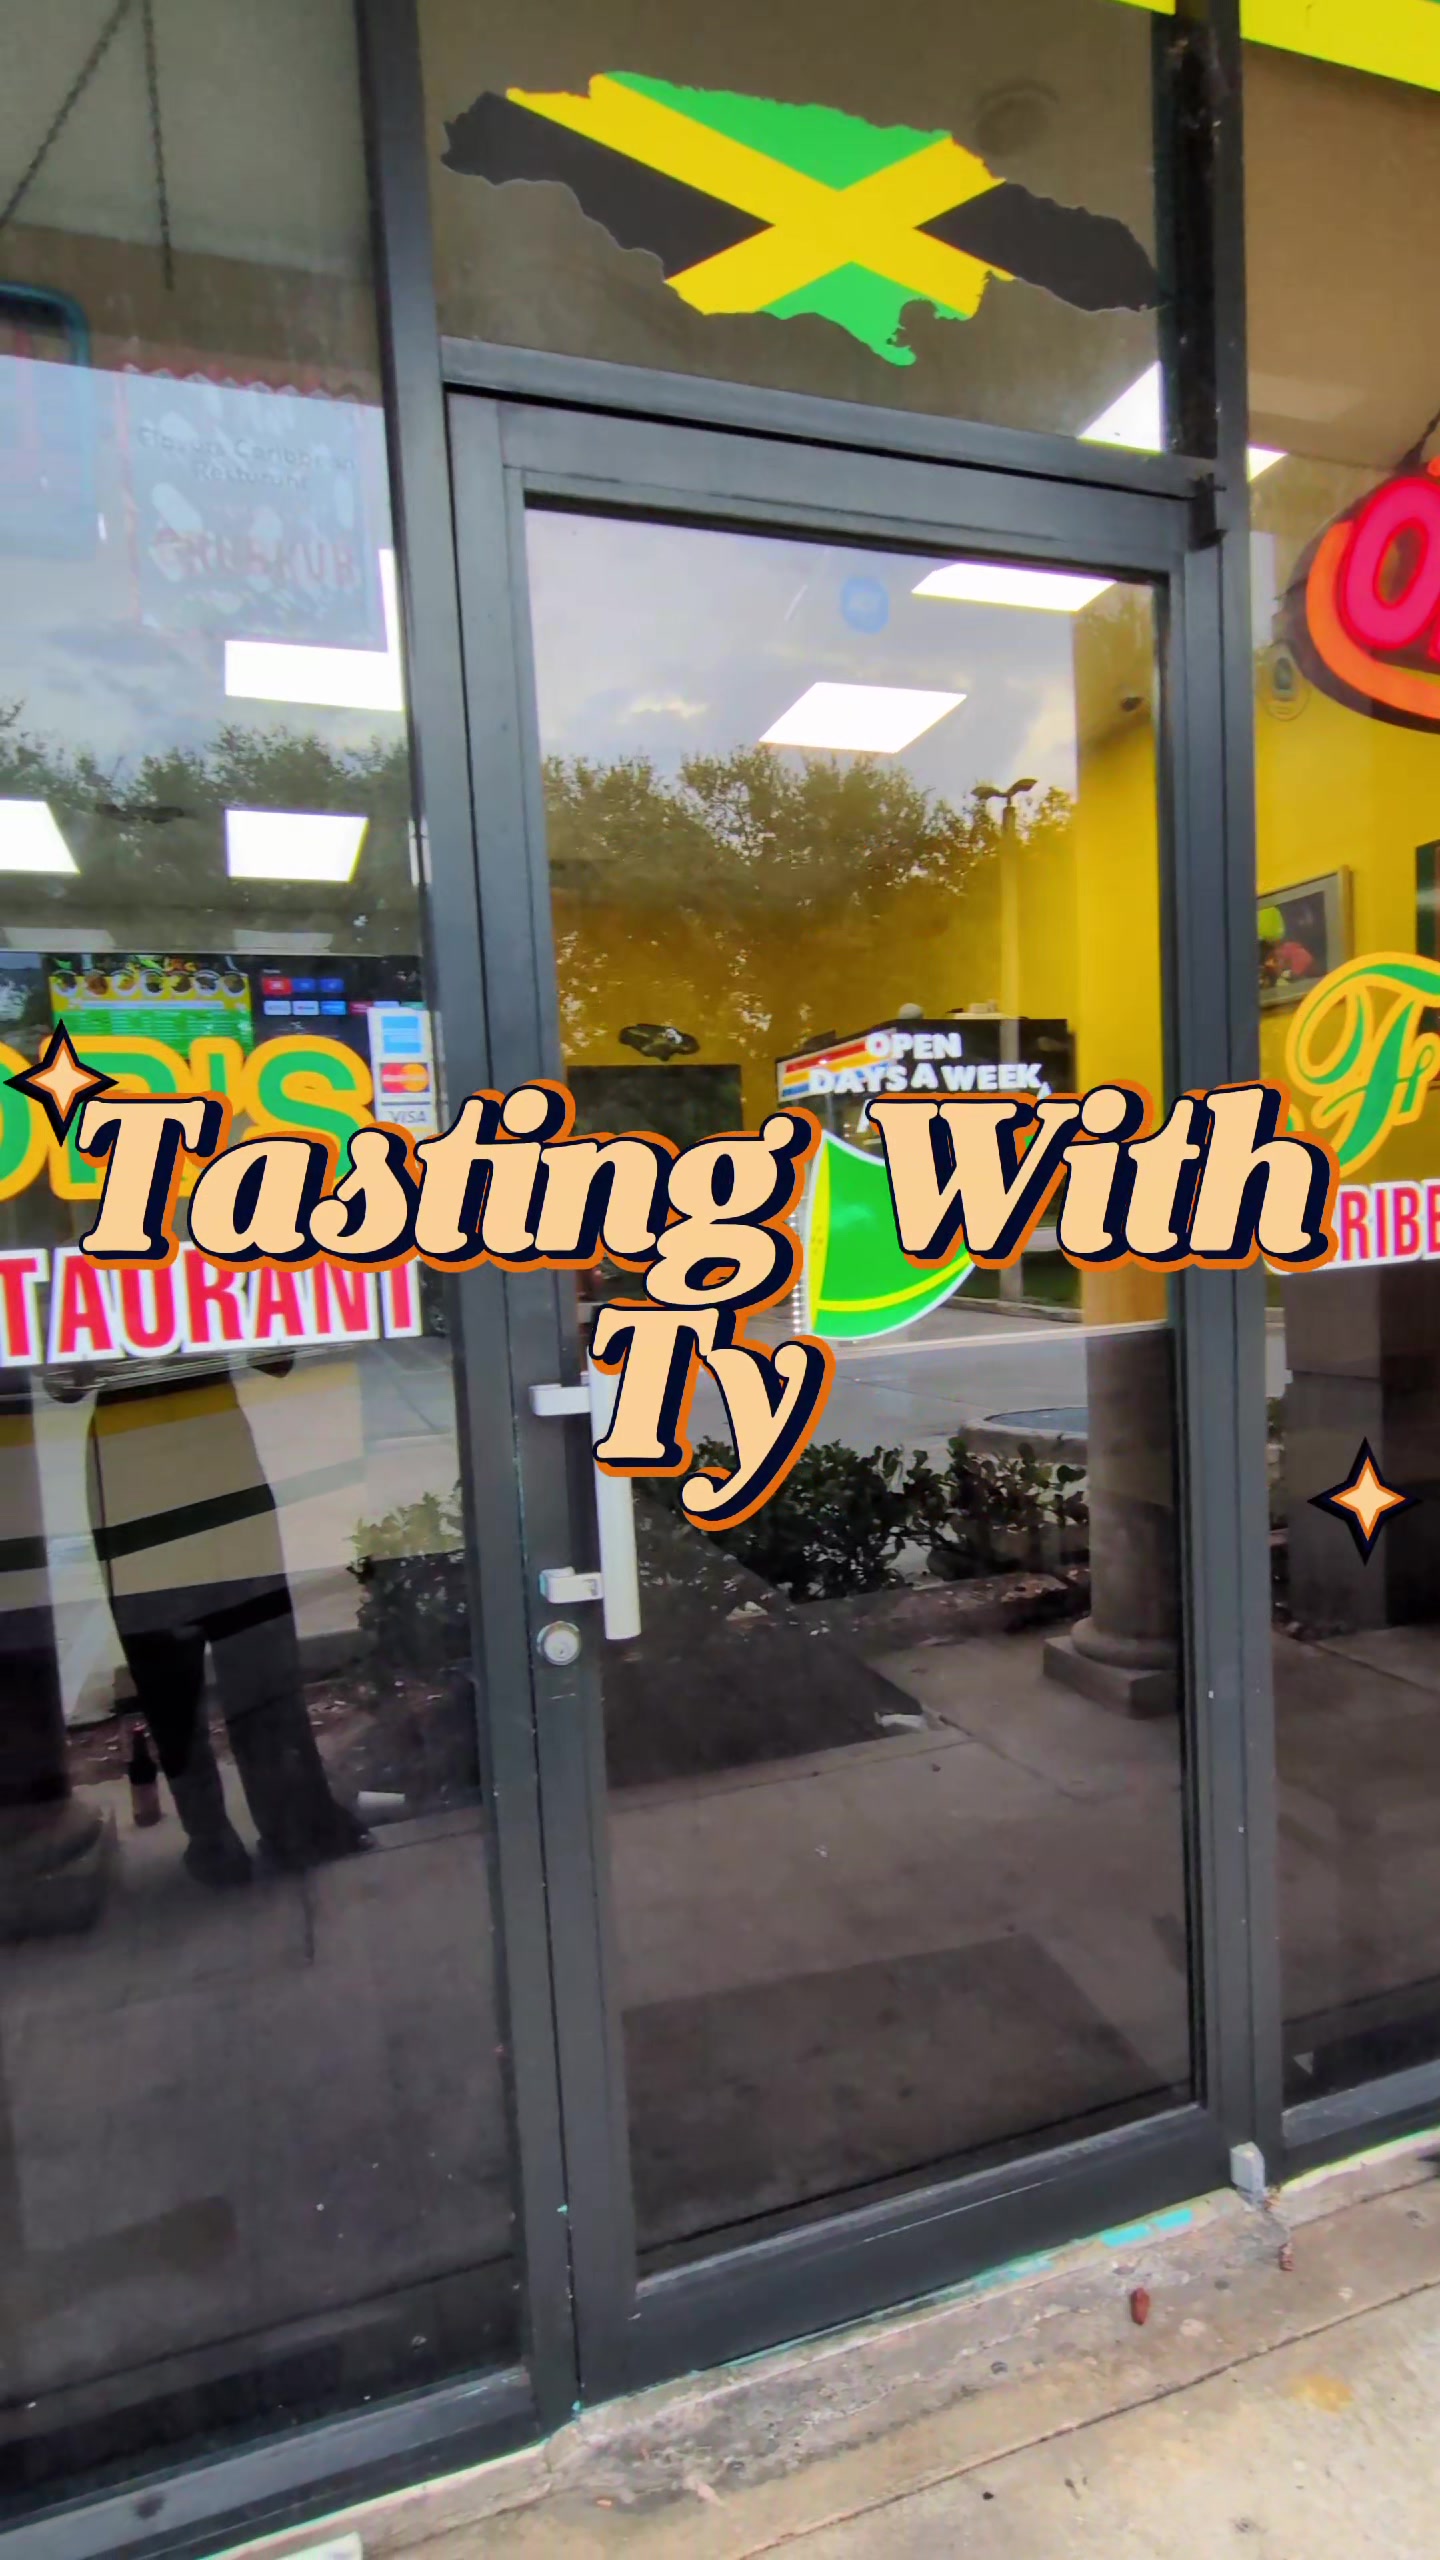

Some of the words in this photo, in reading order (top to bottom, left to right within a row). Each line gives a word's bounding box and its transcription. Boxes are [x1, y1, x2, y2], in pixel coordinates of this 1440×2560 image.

[865, 1031, 962, 1060] OPEN
[808, 1063, 908, 1094] DAYS
[909, 1062, 939, 1090] A
[941, 1062, 1042, 1092] WEEK
[387, 1110, 428, 1125] VISA
